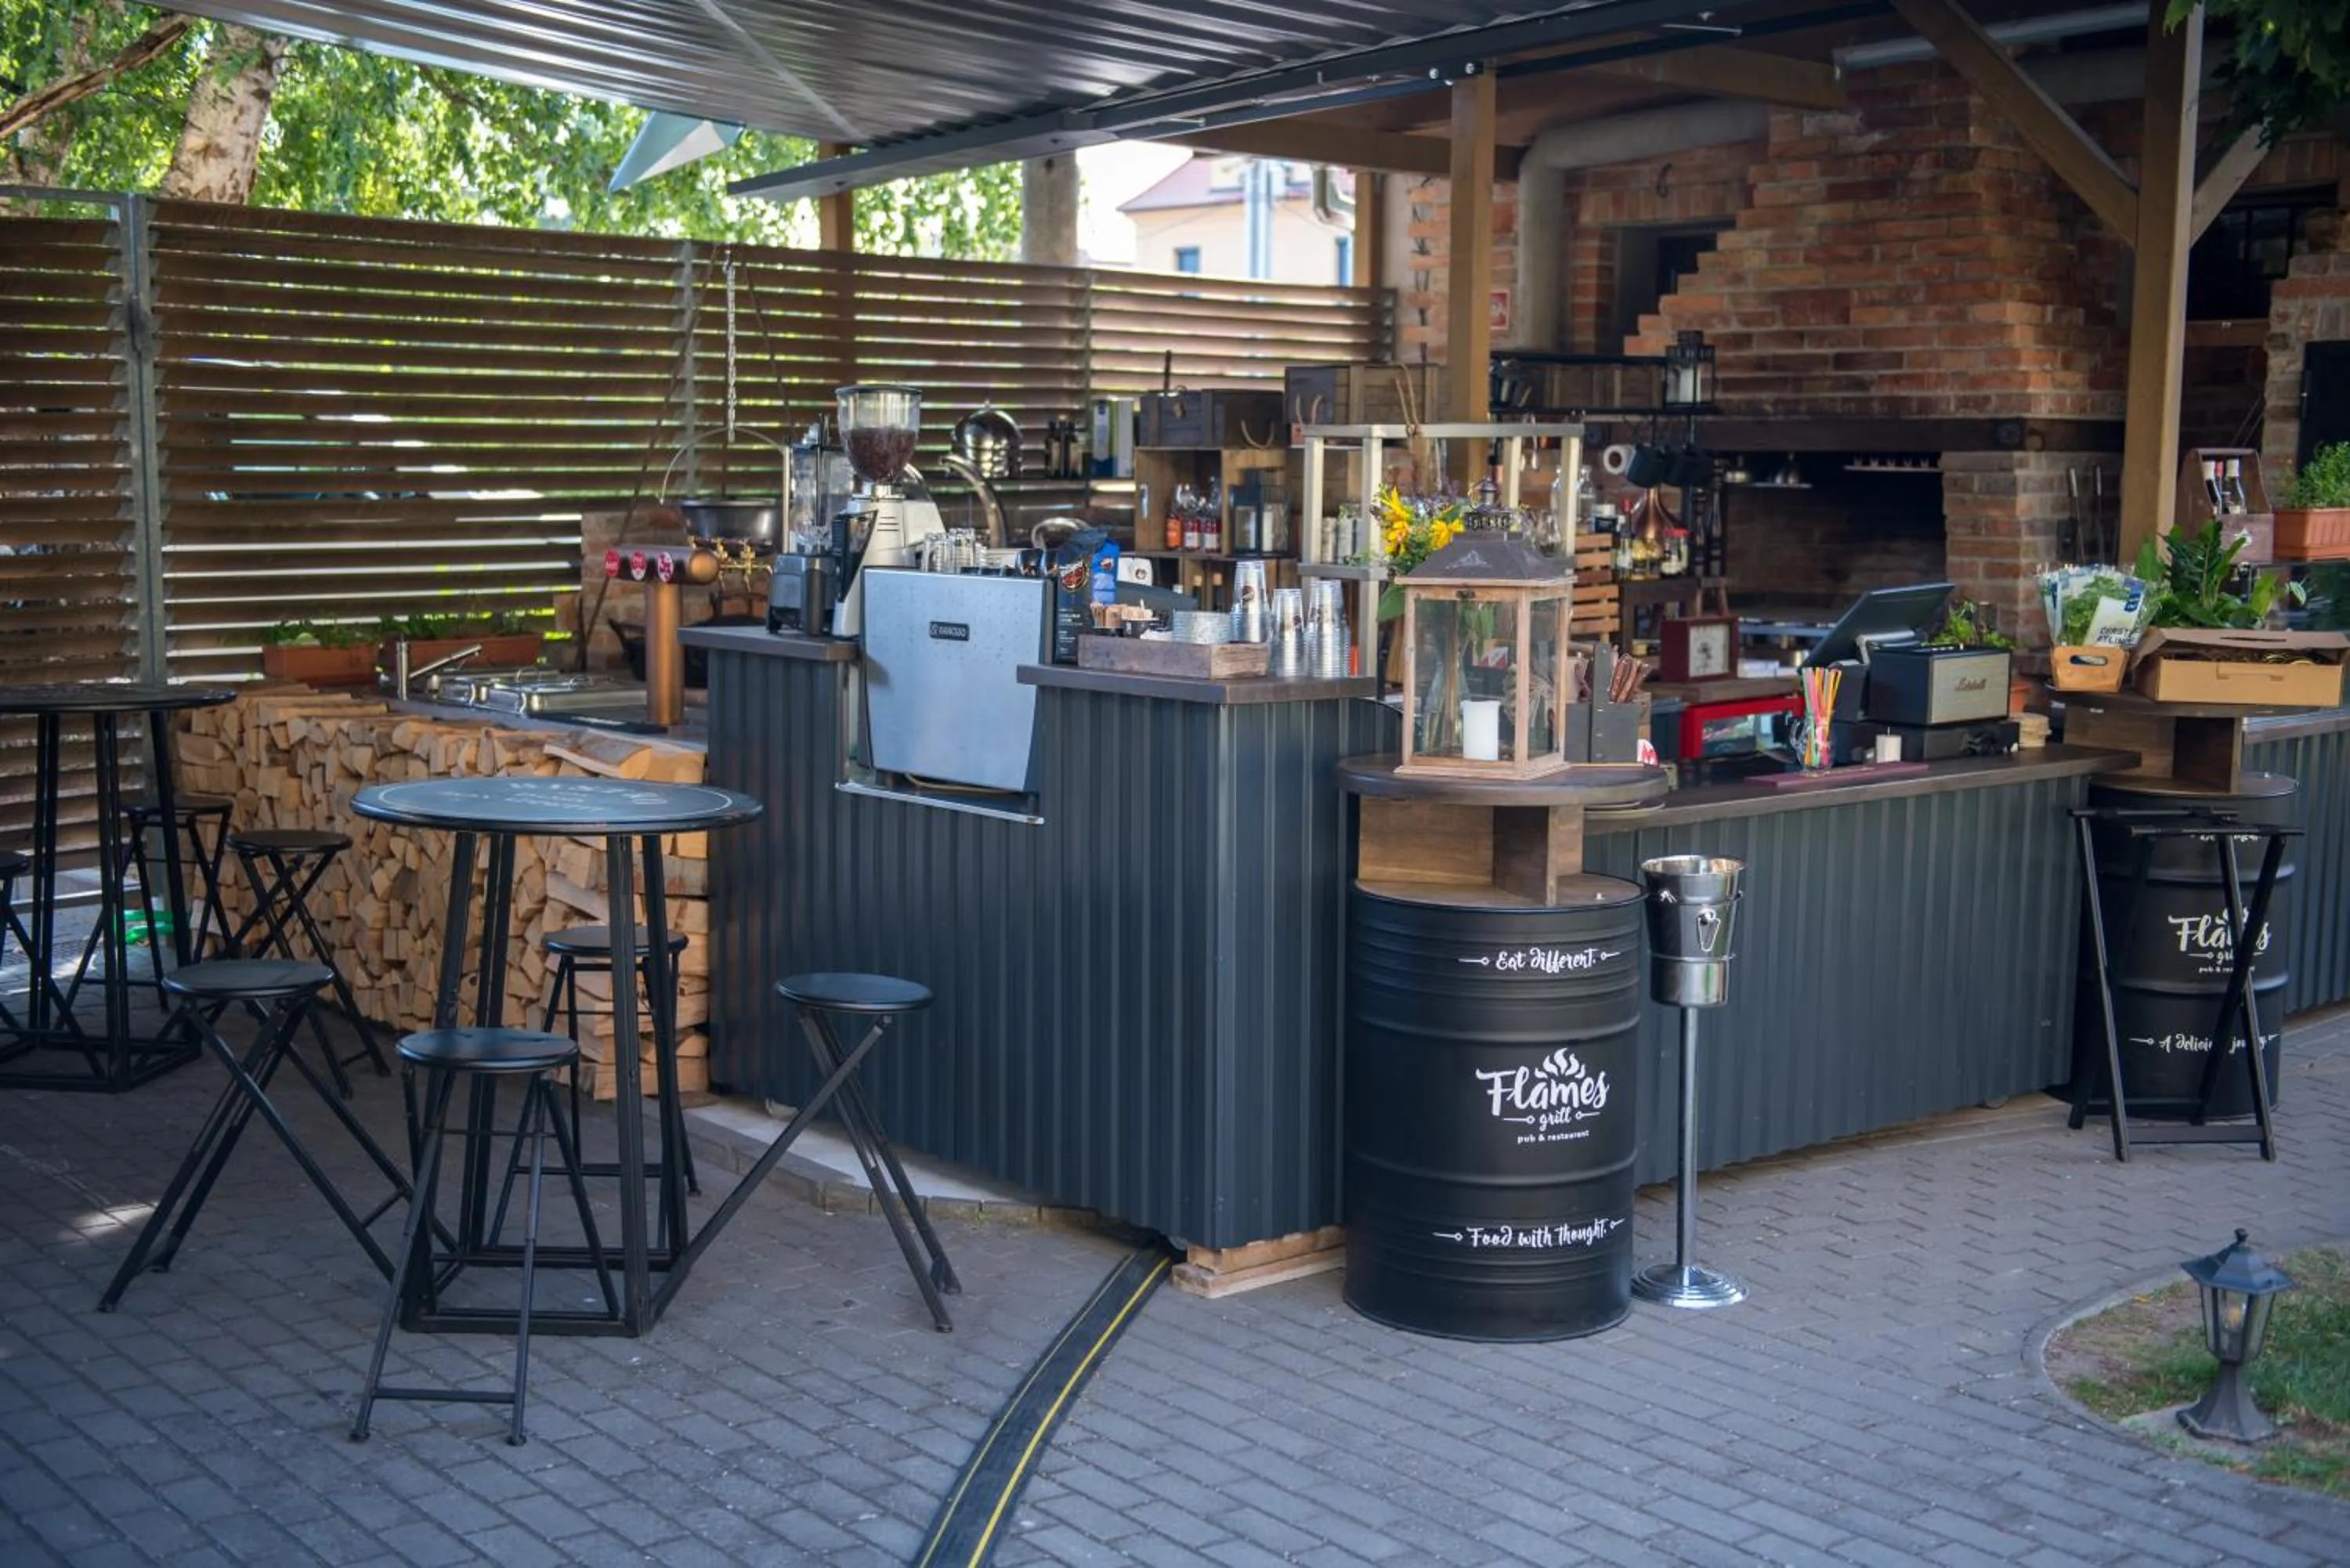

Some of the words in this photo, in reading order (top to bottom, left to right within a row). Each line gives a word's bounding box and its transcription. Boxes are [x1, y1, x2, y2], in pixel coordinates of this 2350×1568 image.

[2167, 914, 2272, 952] Flas
[1495, 950, 1526, 971] Eat
[1529, 947, 1599, 974] different.
[2175, 1033, 2212, 1052] delici
[1475, 1065, 1611, 1116] Flames
[1539, 1105, 1572, 1132] grill
[1517, 1134, 1536, 1145] pub
[1538, 1133, 1546, 1142] &
[1547, 1129, 1590, 1142] restaurant
[1466, 1225, 1513, 1248] Food
[1517, 1225, 1553, 1248] with
